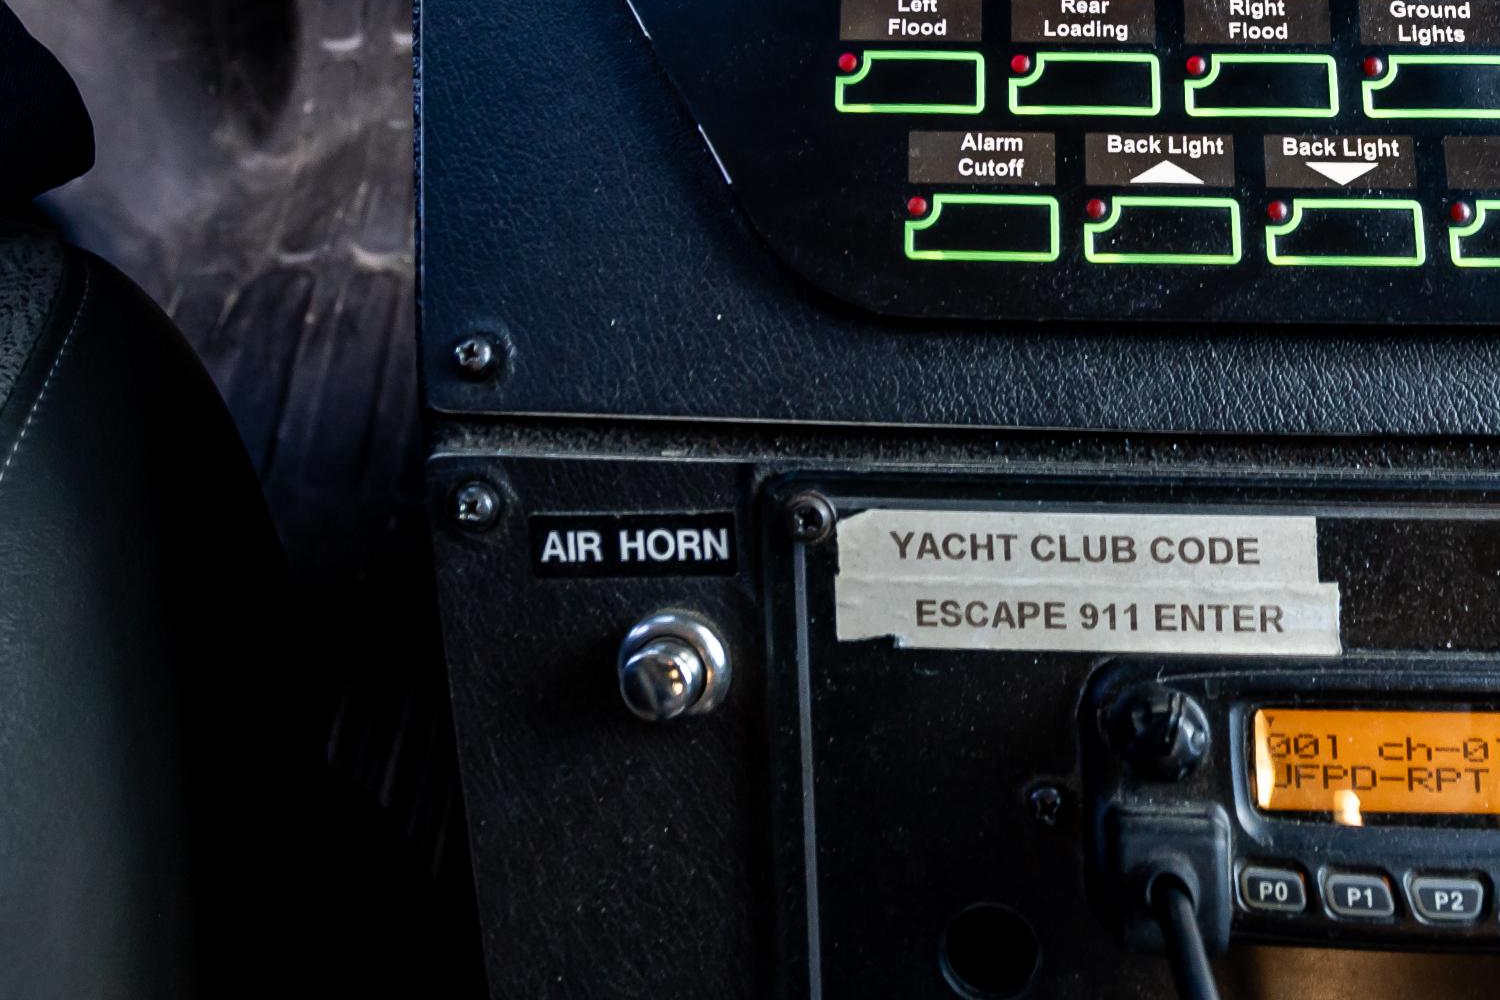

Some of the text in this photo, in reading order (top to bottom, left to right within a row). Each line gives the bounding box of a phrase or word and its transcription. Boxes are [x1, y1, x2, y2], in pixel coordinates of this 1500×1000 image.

[1389, 1, 1472, 20] Ground
[888, 18, 948, 37] Flood
[1043, 19, 1129, 41] Loading
[1228, 21, 1289, 40] Flood
[1398, 23, 1466, 44] Lights
[960, 133, 1024, 153] Alarm
[1107, 134, 1224, 157] Back Light
[1282, 137, 1400, 160] Back Light
[958, 157, 1025, 177] Cutoff
[540, 528, 731, 565] AIR HORN
[888, 530, 1261, 568] YACHT CLUB CODE
[915, 598, 1286, 635] ESCAPE 911 ENTER
[1267, 732, 1338, 761] 001
[1258, 880, 1289, 904] P0
[1346, 887, 1374, 910] P1
[1433, 891, 1465, 914] P2
